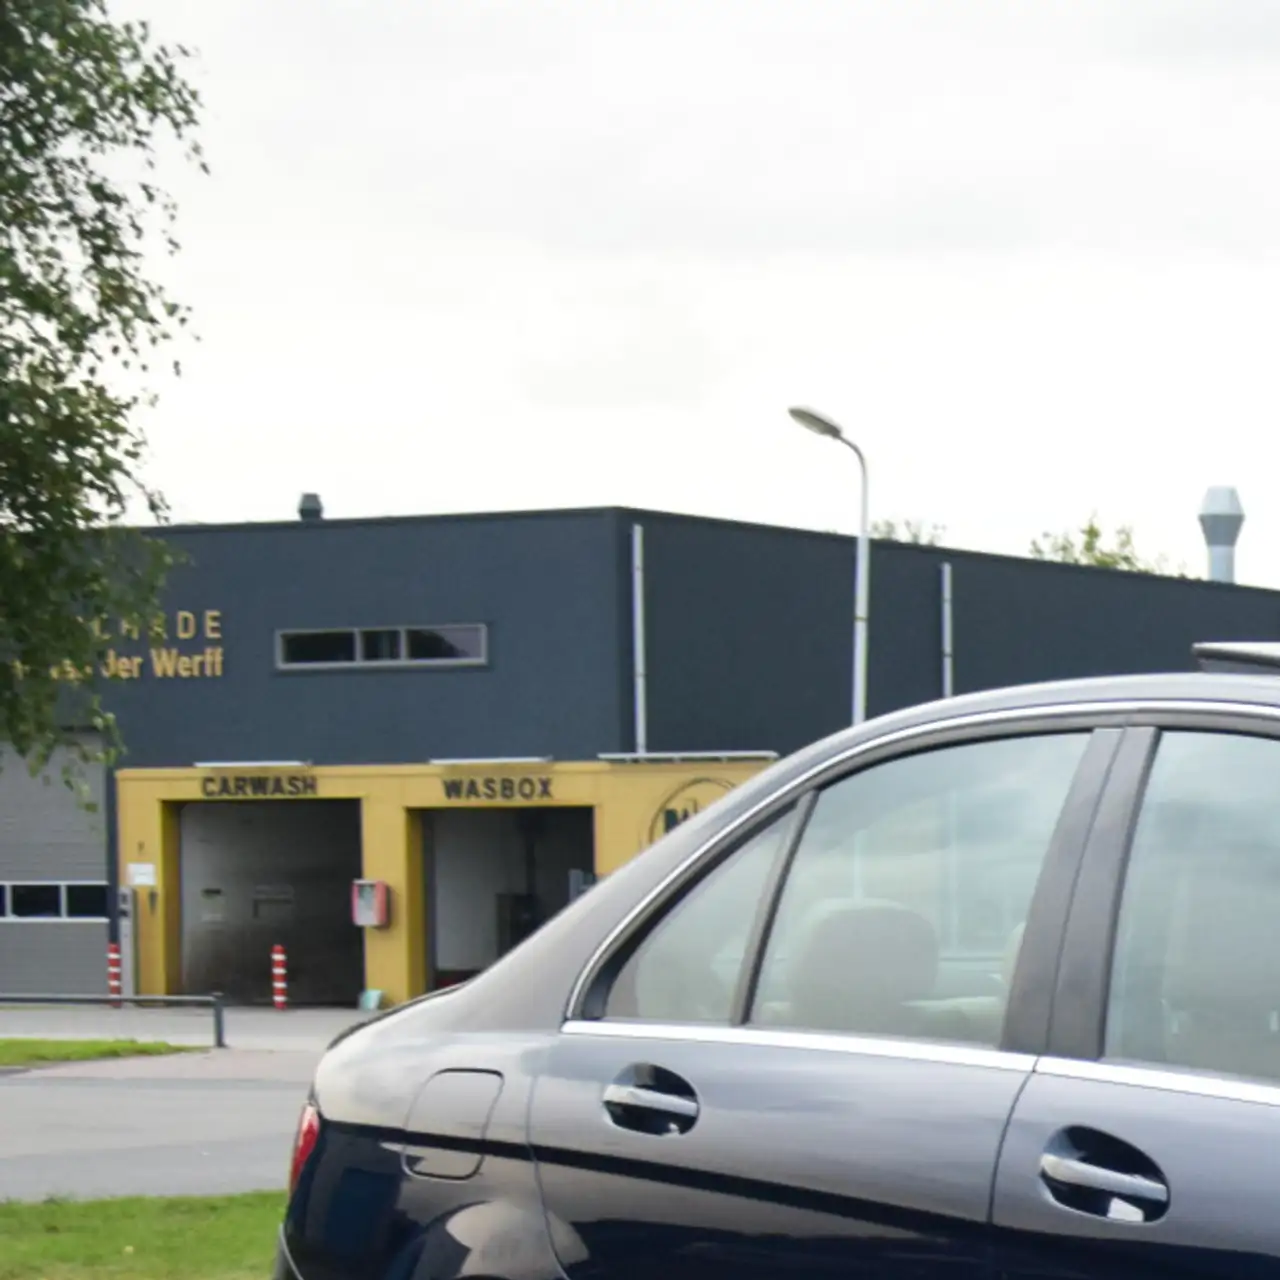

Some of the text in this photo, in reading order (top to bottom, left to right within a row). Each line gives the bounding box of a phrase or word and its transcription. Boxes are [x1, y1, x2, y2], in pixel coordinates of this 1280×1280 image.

[150, 647, 224, 679] Werff
[202, 777, 318, 798] CARWASH
[443, 777, 554, 800] WASBOX
